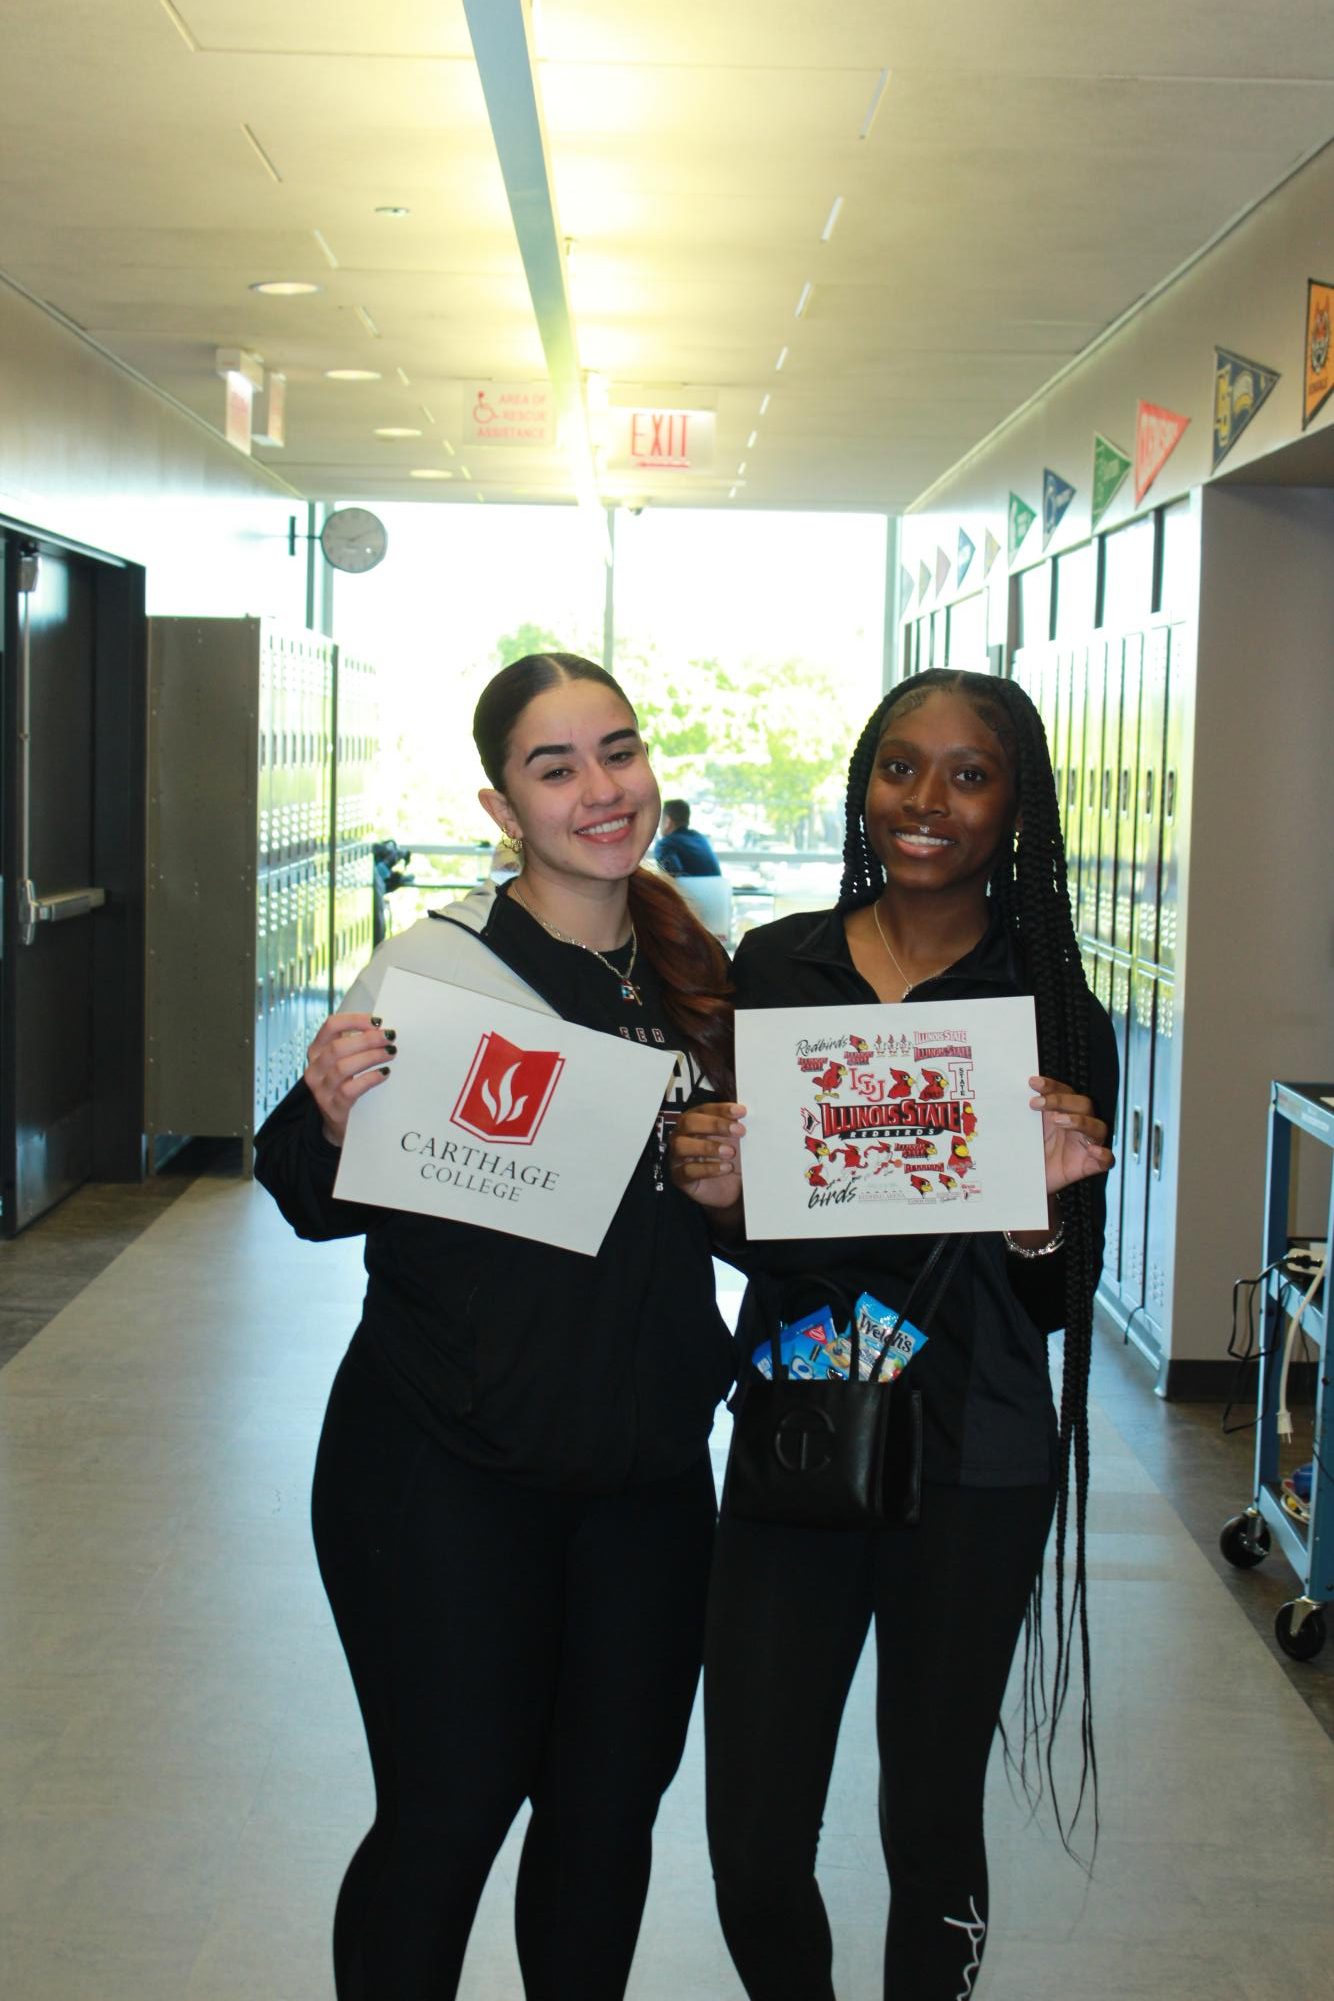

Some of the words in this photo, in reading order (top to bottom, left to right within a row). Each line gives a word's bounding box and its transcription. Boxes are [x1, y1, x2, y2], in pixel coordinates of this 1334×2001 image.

[630, 413, 688, 457] EXIT
[795, 1035, 848, 1057] Redbirds
[820, 1103, 898, 1138] ILLINOIS
[899, 1099, 962, 1133] STATE
[850, 1128, 935, 1138] REDBIRDS
[400, 1130, 560, 1192] CARTHAGE
[420, 1162, 522, 1202] COLLEGE
[808, 1180, 857, 1209] birds
